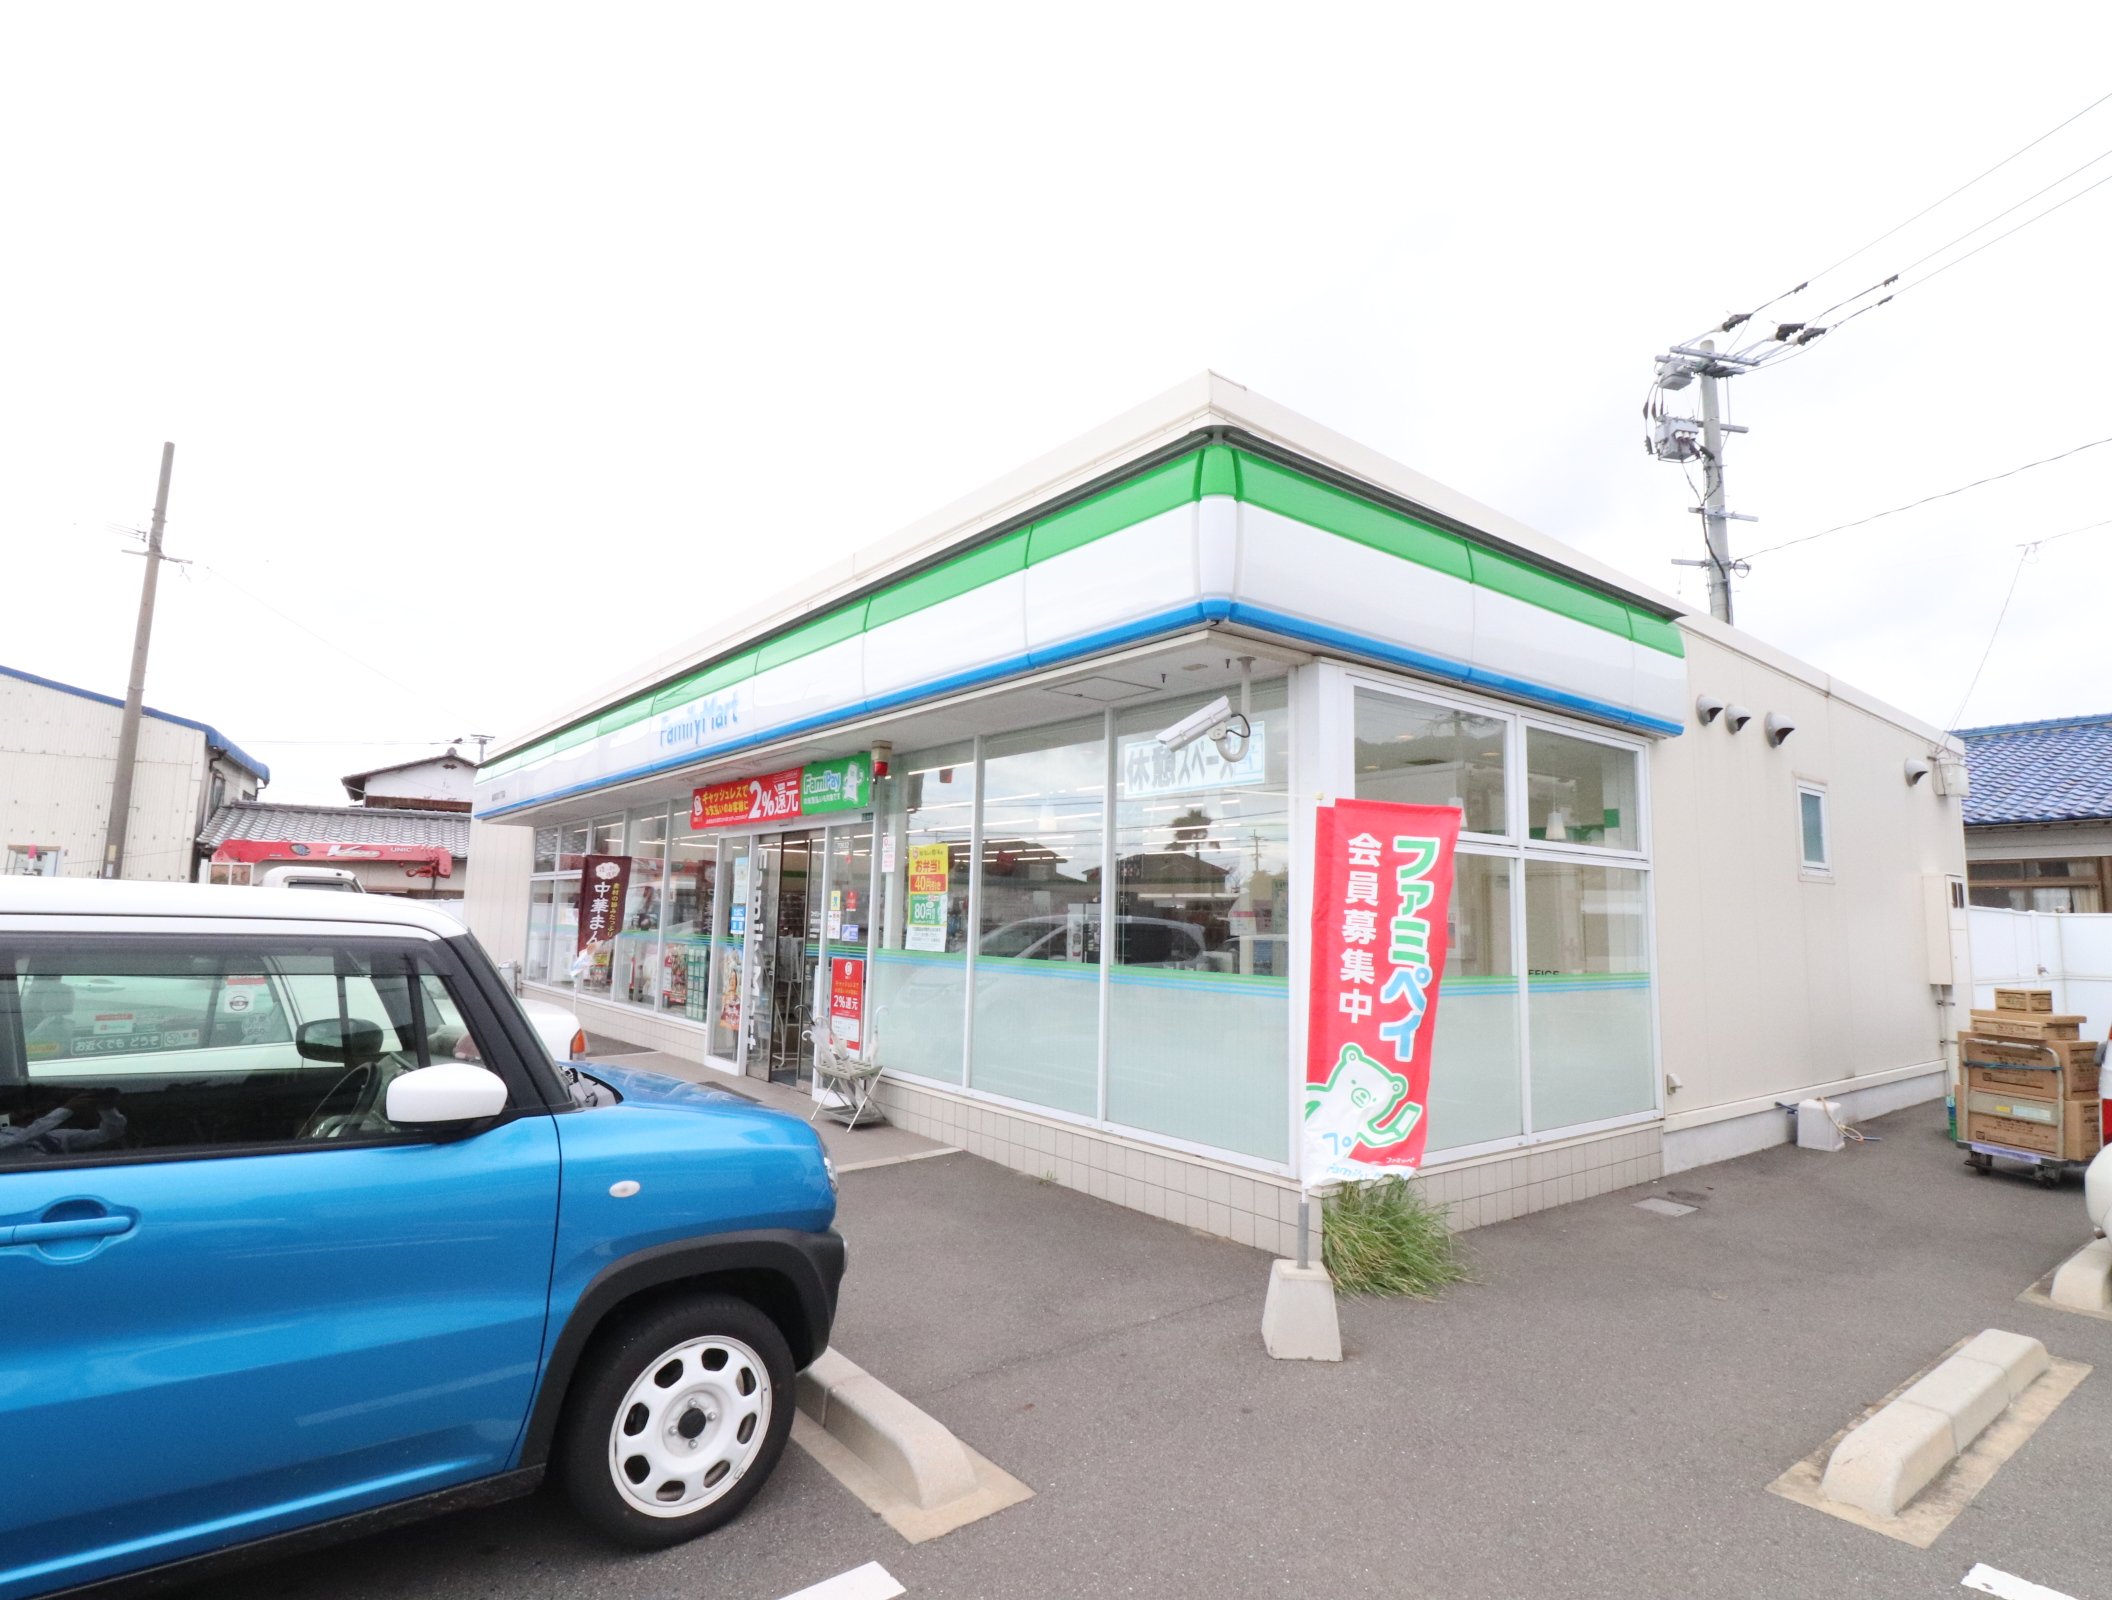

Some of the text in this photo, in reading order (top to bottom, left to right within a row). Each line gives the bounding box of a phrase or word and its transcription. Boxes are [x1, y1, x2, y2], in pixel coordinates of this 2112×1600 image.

[660, 691, 739, 747] FamilyMart
[748, 779, 799, 819] 2%還元
[1337, 832, 1384, 1024] 会員募集中
[1379, 836, 1441, 1062] ファミペイ
